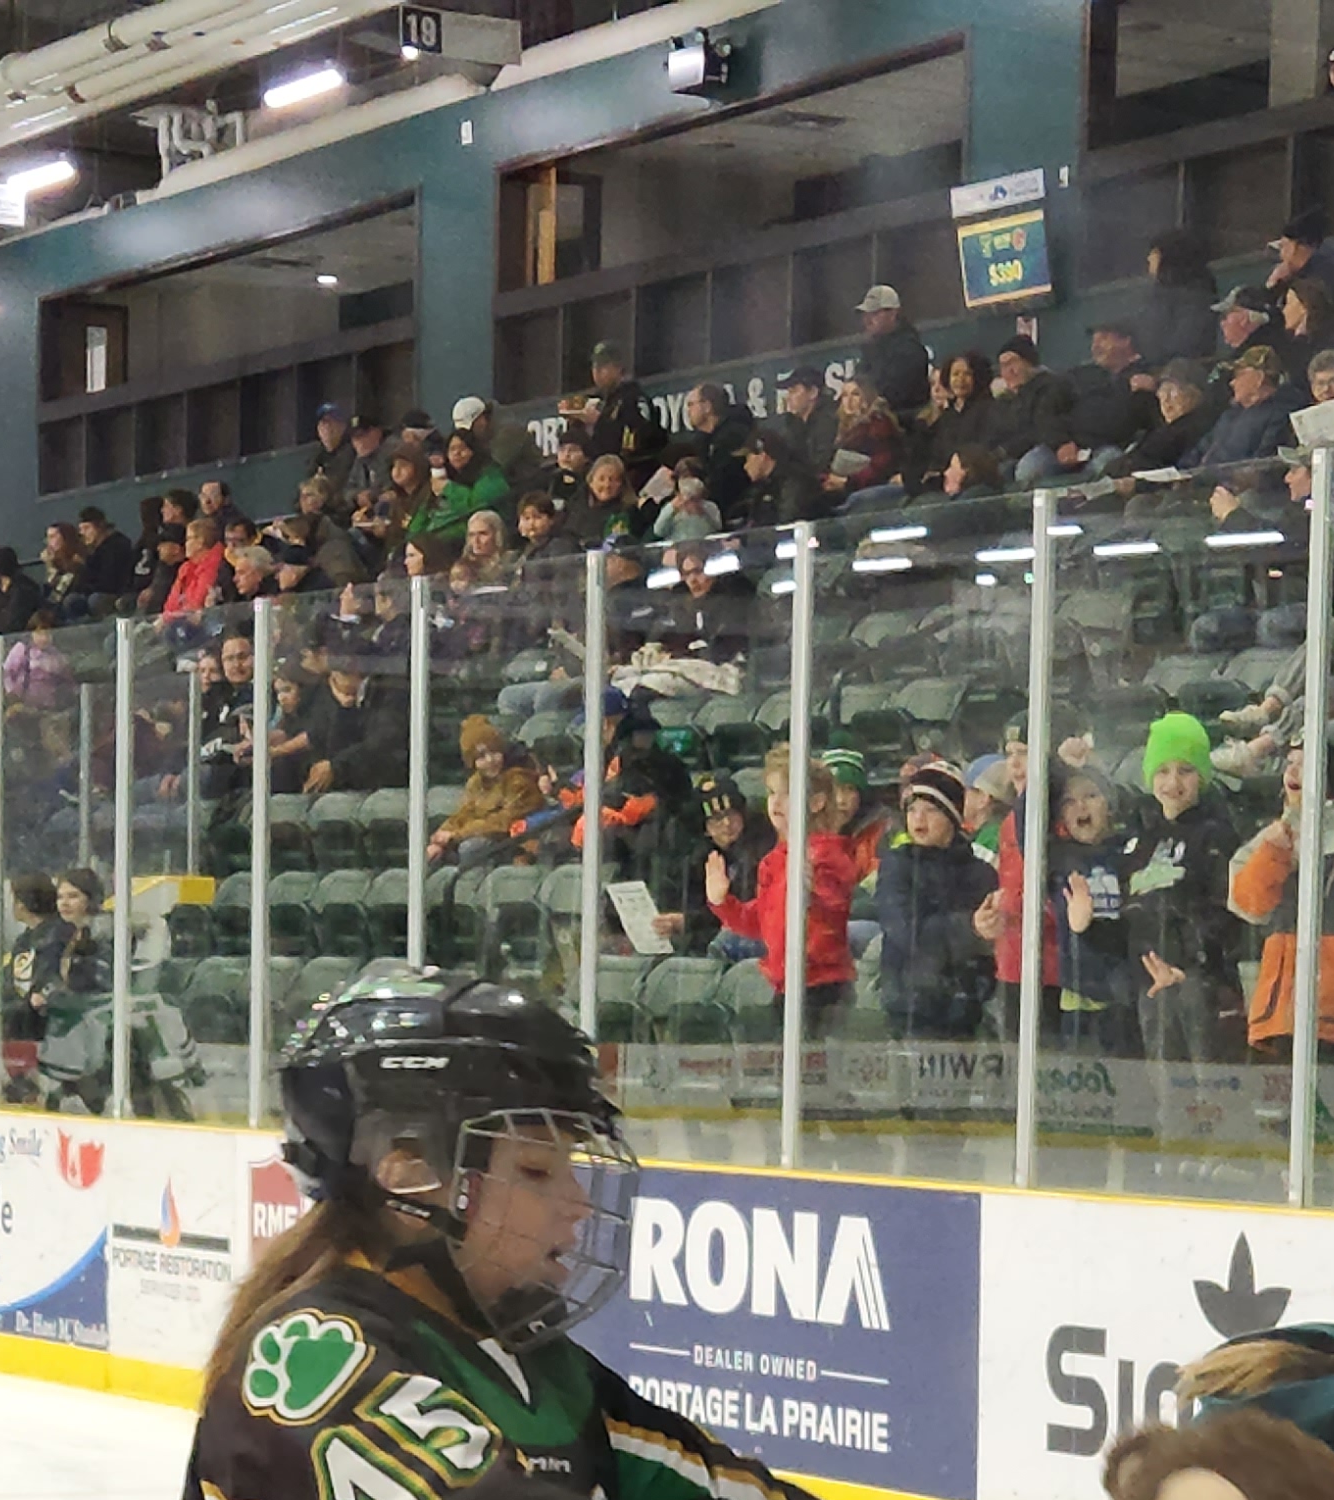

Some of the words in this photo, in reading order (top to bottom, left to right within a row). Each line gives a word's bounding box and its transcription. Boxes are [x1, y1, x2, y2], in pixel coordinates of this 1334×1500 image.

[405, 12, 437, 47] 19
[378, 1055, 452, 1070] CCM
[112, 1246, 158, 1273] PORTAGE
[159, 1252, 232, 1282] RESTORATION
[629, 1196, 892, 1331] RONA
[693, 1344, 755, 1373] DEALER
[760, 1354, 818, 1383] OWNED
[745, 1392, 780, 1437] LA
[782, 1397, 891, 1454] PRAIRIE
